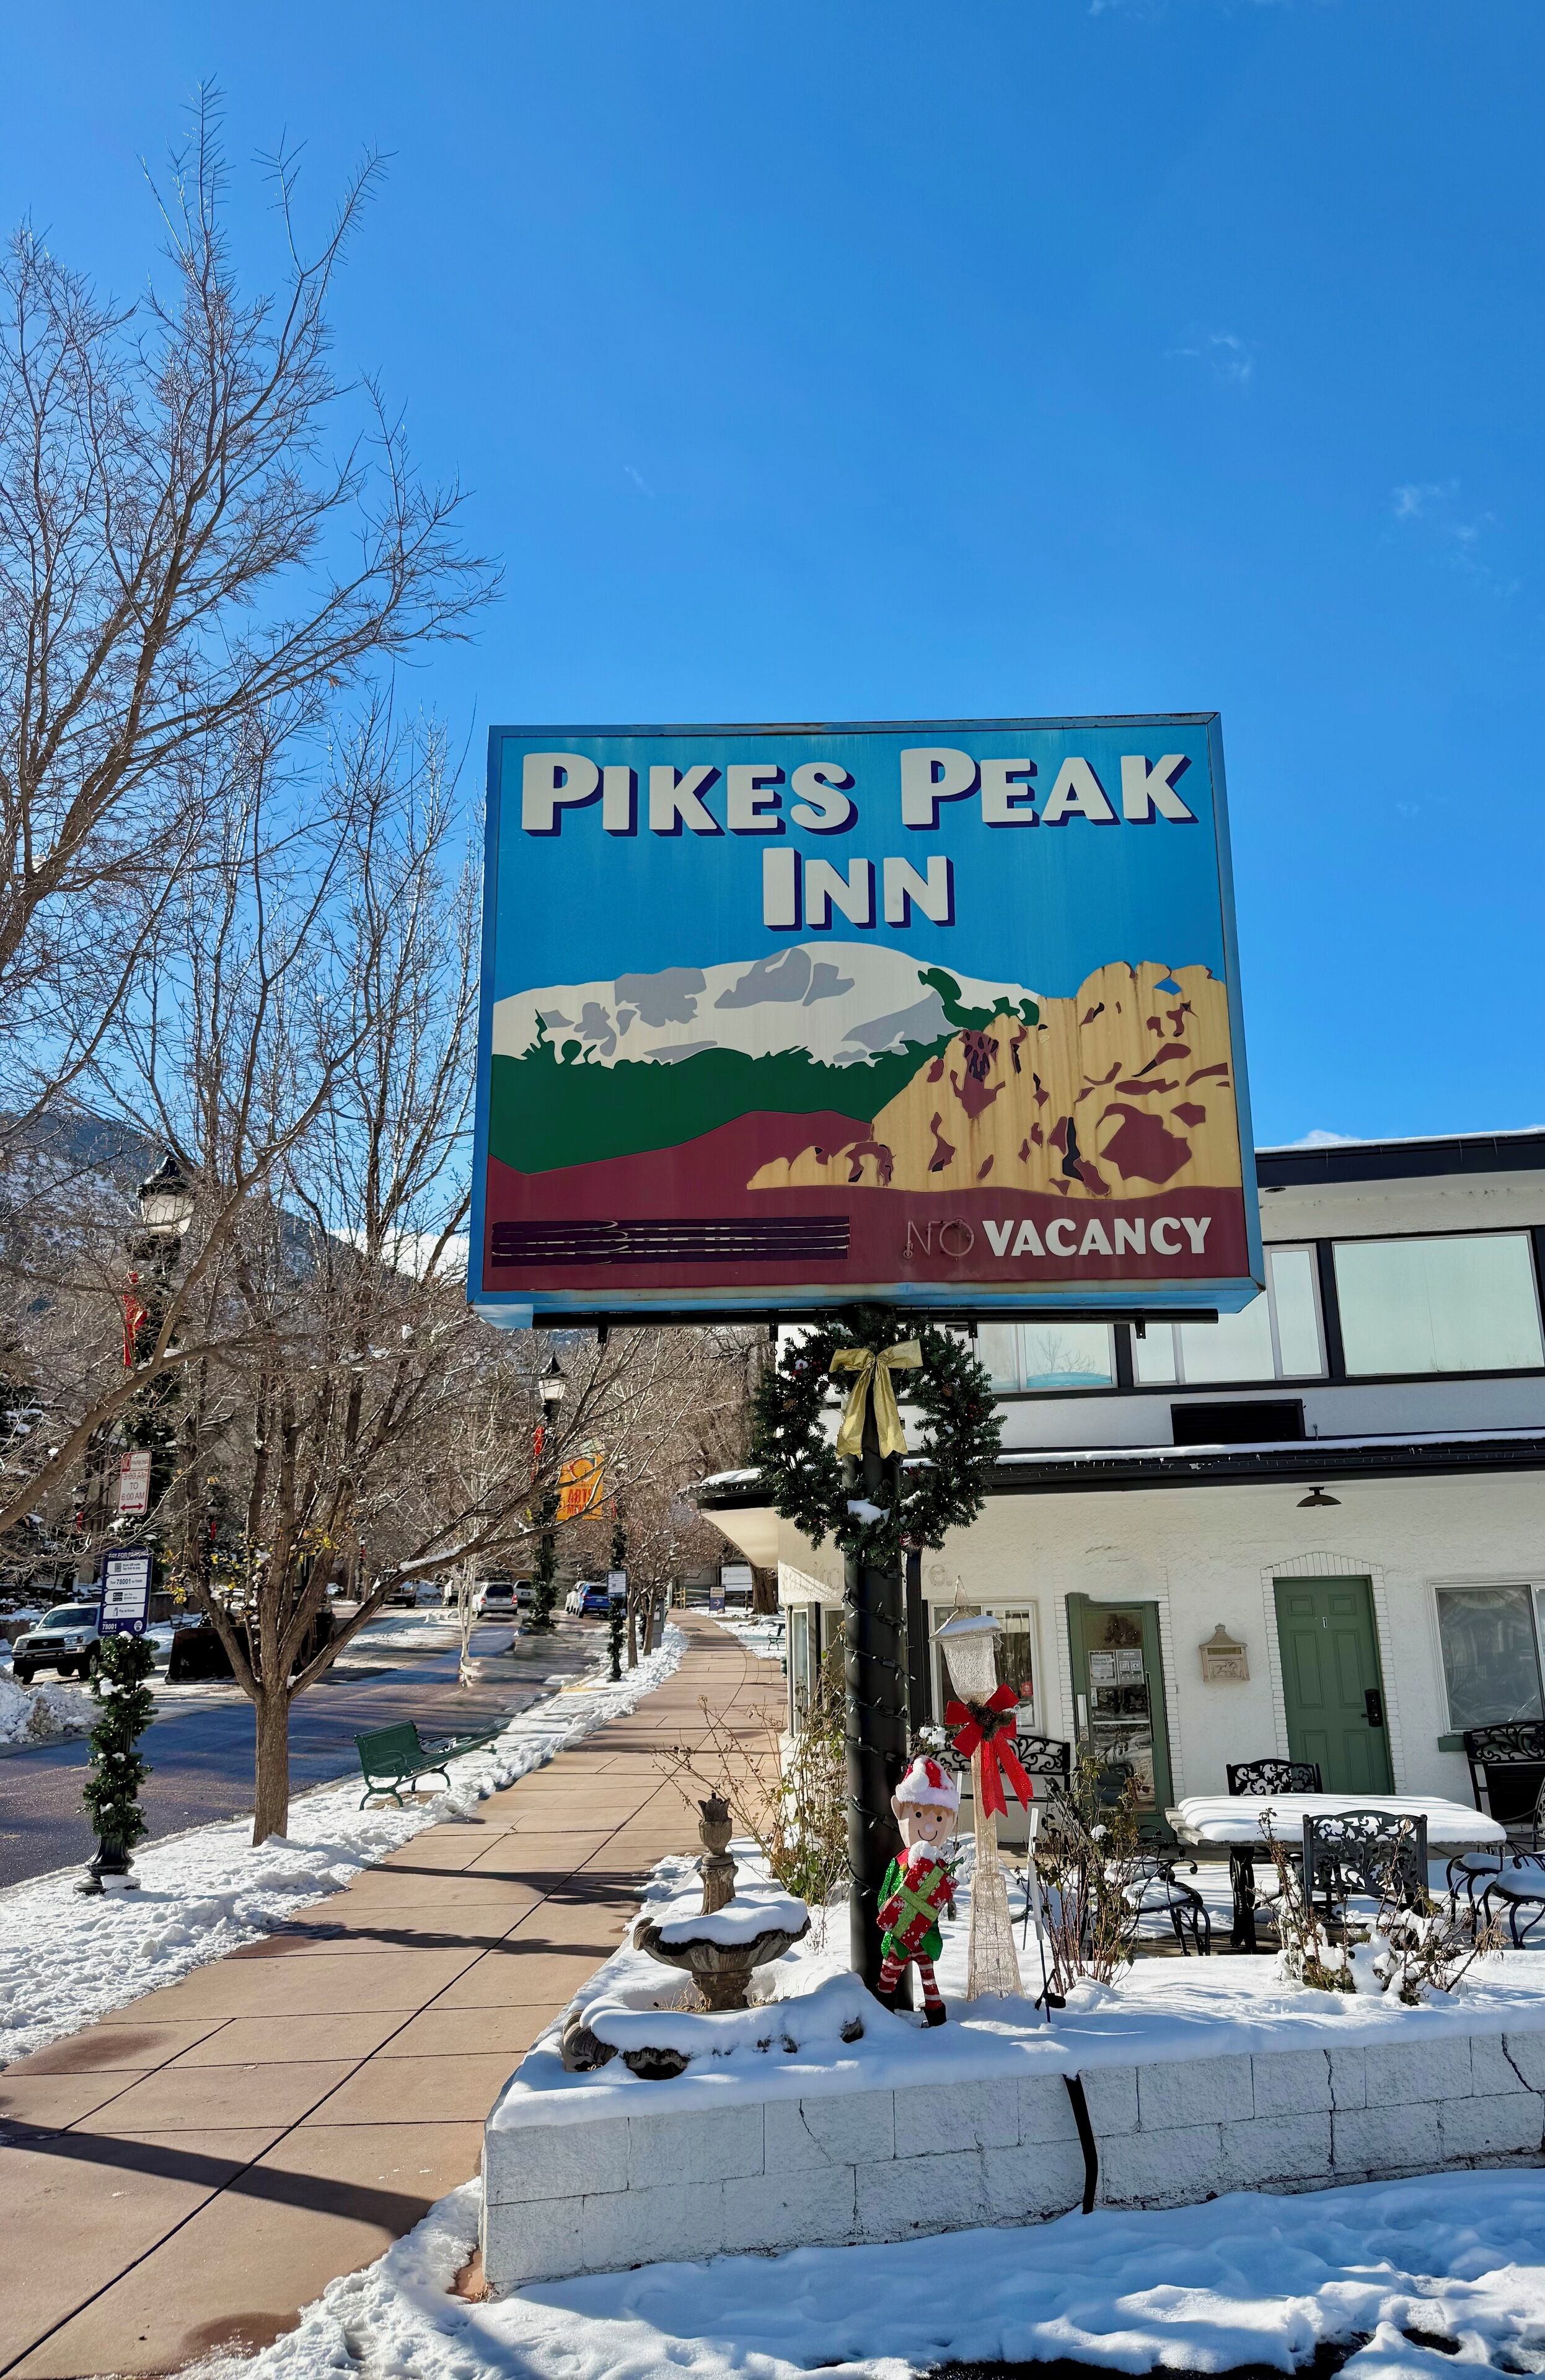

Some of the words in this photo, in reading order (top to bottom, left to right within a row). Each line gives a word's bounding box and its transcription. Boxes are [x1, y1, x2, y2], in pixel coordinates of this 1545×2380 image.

[521, 752, 859, 837] PIKES
[900, 747, 1199, 831] PEAK
[763, 847, 955, 932] INN
[982, 1217, 1212, 1257] VACANCY
